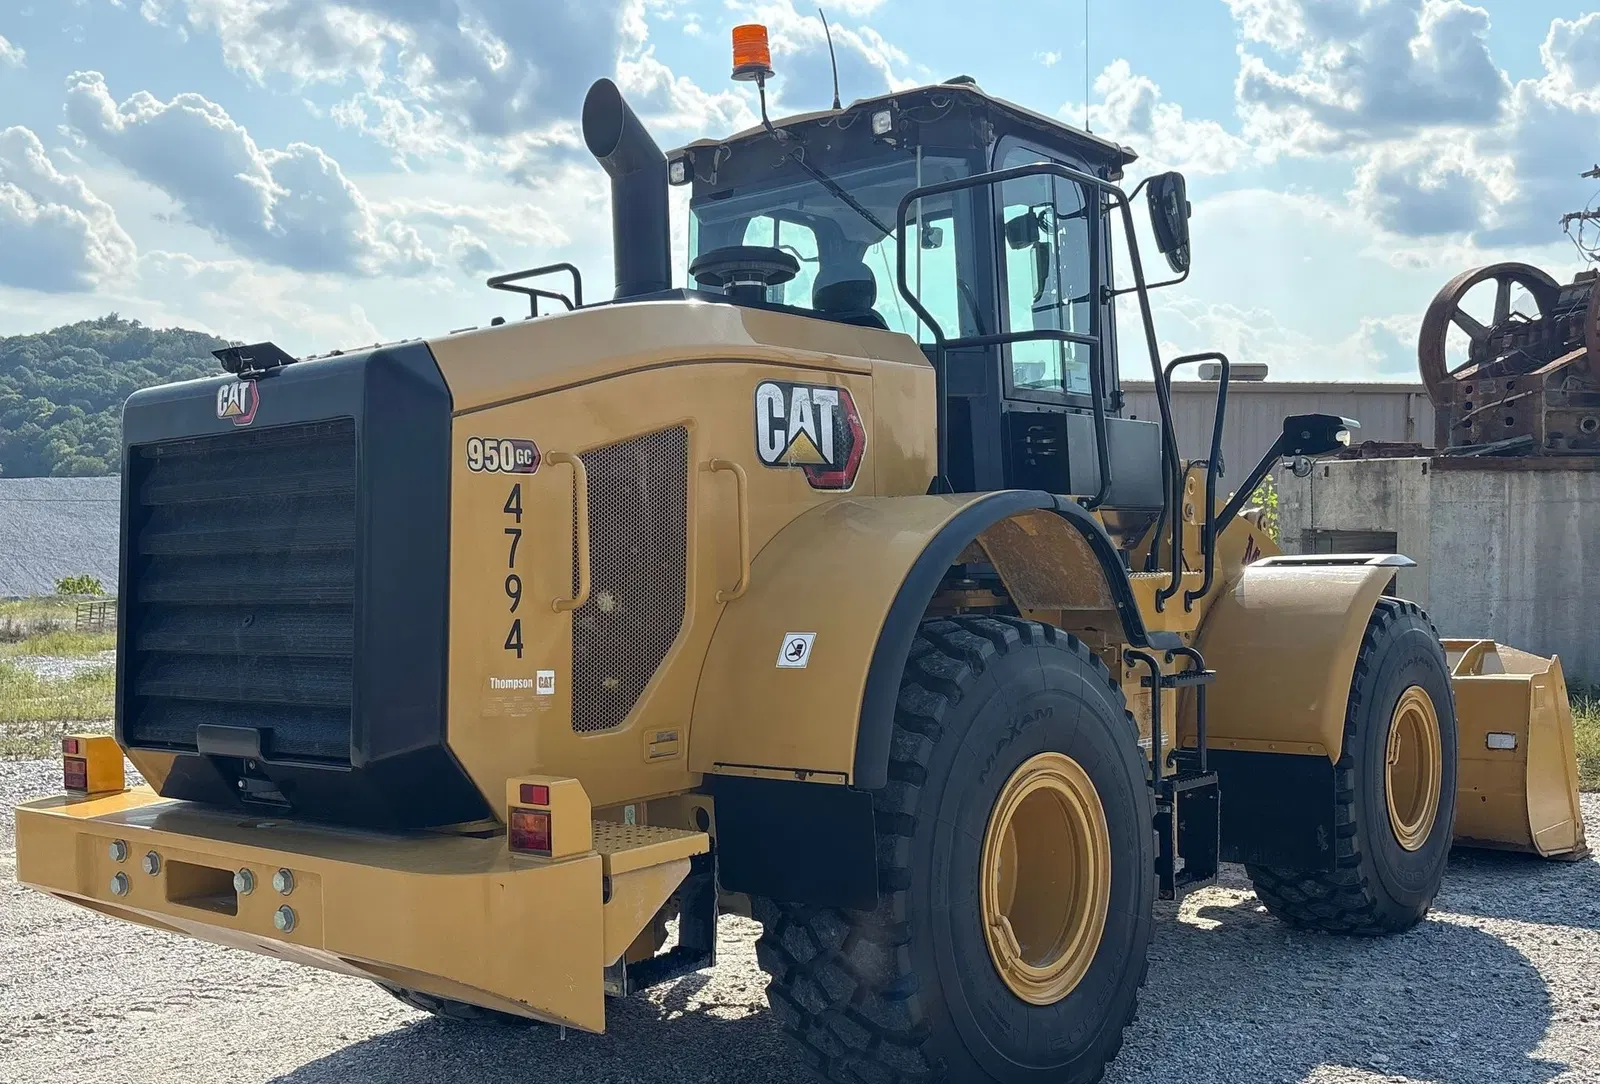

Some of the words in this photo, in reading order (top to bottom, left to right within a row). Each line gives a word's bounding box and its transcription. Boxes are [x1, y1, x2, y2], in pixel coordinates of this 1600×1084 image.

[217, 381, 250, 417] CAT
[756, 383, 839, 465] CAT
[467, 438, 515, 471] 950
[515, 448, 532, 465] GC
[490, 677, 533, 690] Thompson
[538, 676, 553, 688] CAT
[979, 706, 1053, 784] MAXAM
